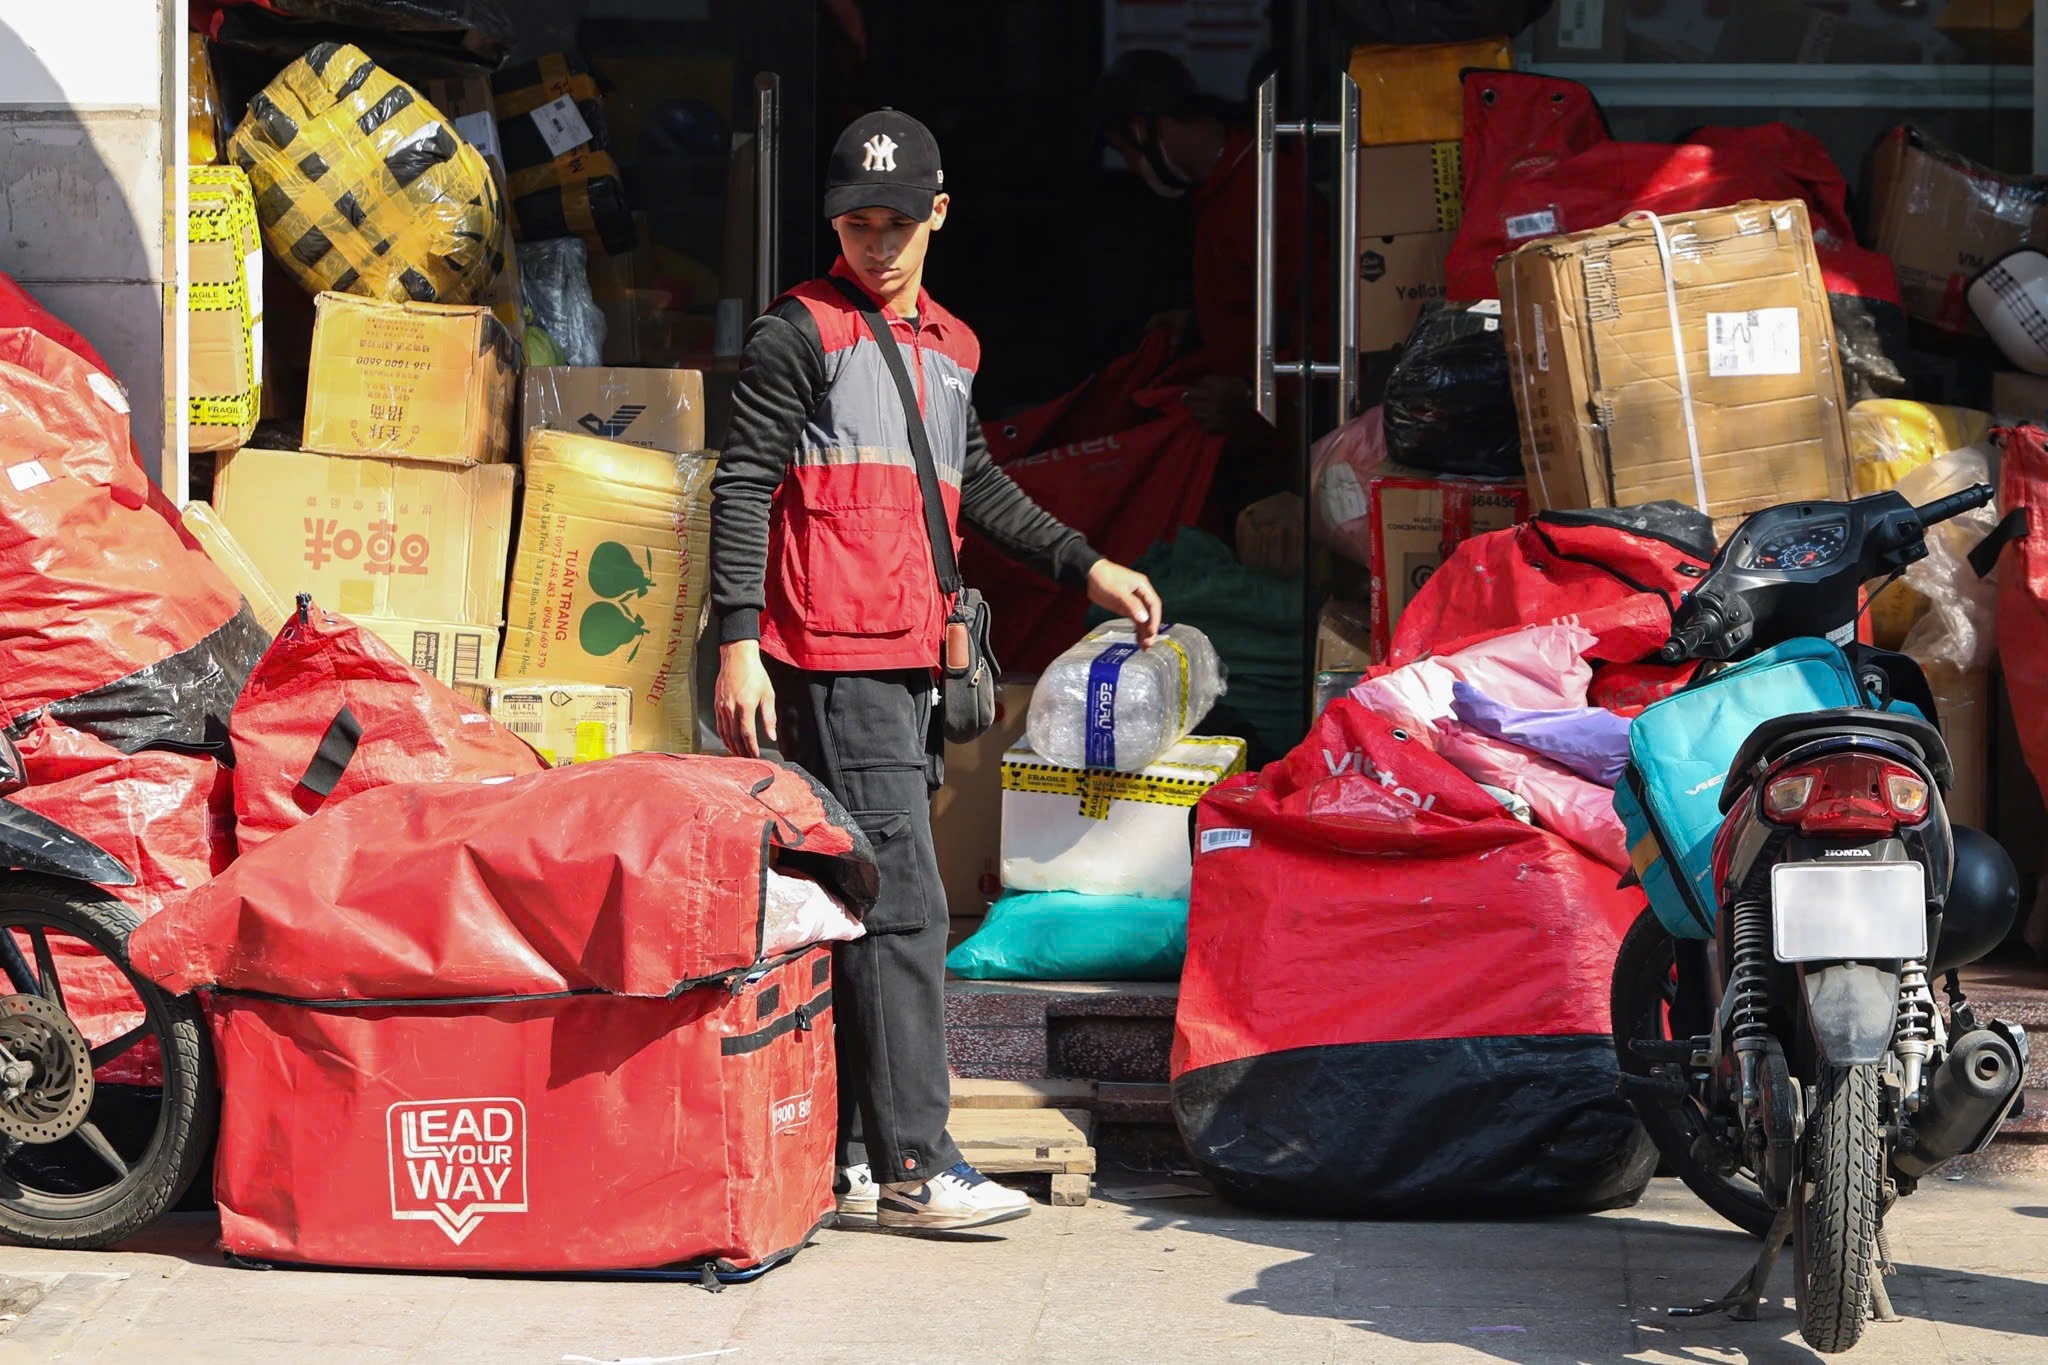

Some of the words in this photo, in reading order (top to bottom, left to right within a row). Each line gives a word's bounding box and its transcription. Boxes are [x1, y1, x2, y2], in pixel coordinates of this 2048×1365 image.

[863, 134, 898, 171] NY
[188, 290, 218, 299] RAGILE
[356, 356, 381, 367] 6600
[413, 361, 431, 371] 136
[370, 403, 403, 420] 招商
[369, 424, 402, 441] 全球
[552, 536, 564, 559] 0973
[549, 561, 560, 579] 448
[546, 581, 557, 598] 483
[541, 606, 553, 629] 0984
[555, 592, 573, 641] TRANG
[536, 650, 547, 668] 379
[1027, 774, 1067, 783] FRAGILE
[1824, 849, 1872, 857] HONDA
[401, 1108, 513, 1158] LEAD
[439, 1145, 512, 1165] YOUR
[406, 1160, 512, 1200] WAY
